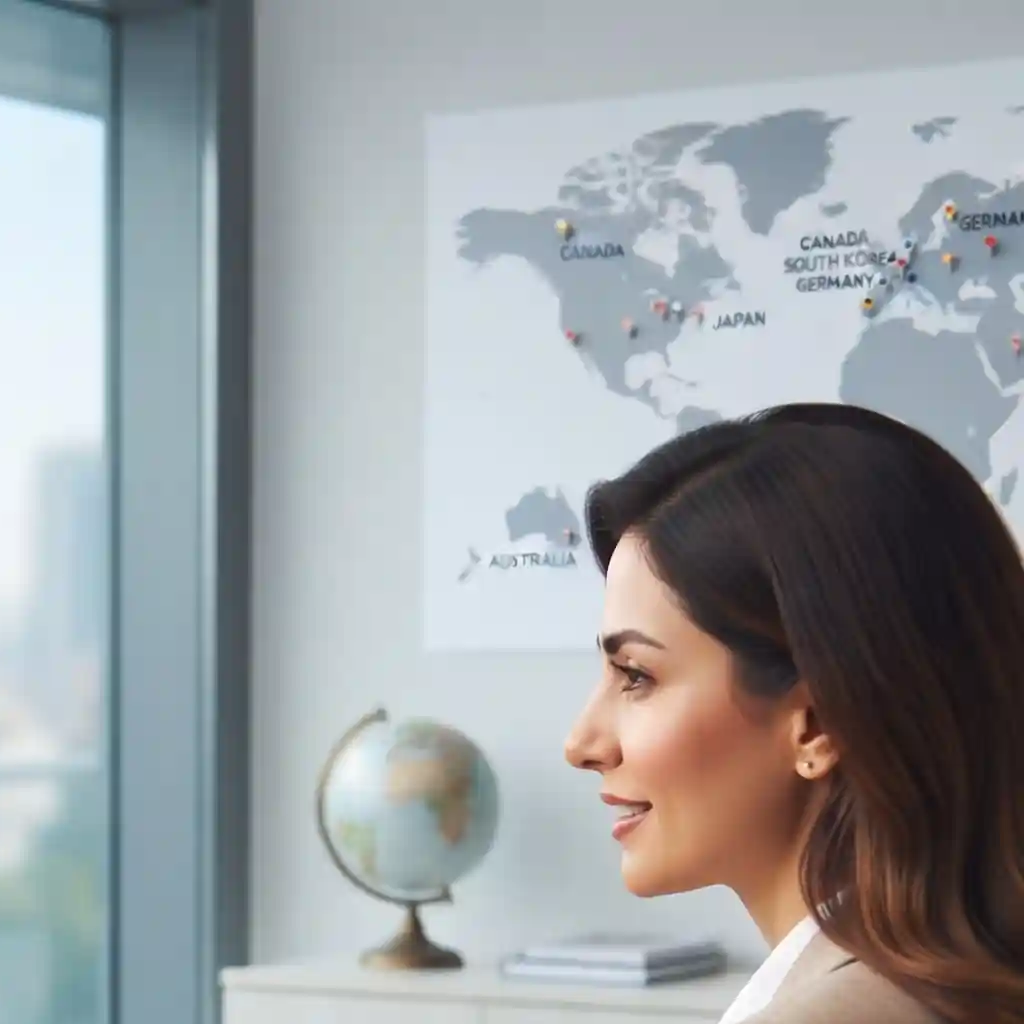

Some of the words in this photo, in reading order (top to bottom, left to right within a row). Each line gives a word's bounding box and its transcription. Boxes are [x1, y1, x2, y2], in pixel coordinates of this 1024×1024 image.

[800, 229, 869, 250] CANADA
[560, 243, 624, 260] CANADA
[784, 254, 839, 273] SOUTH
[796, 273, 874, 292] GERMANY
[713, 311, 766, 330] JAPAN
